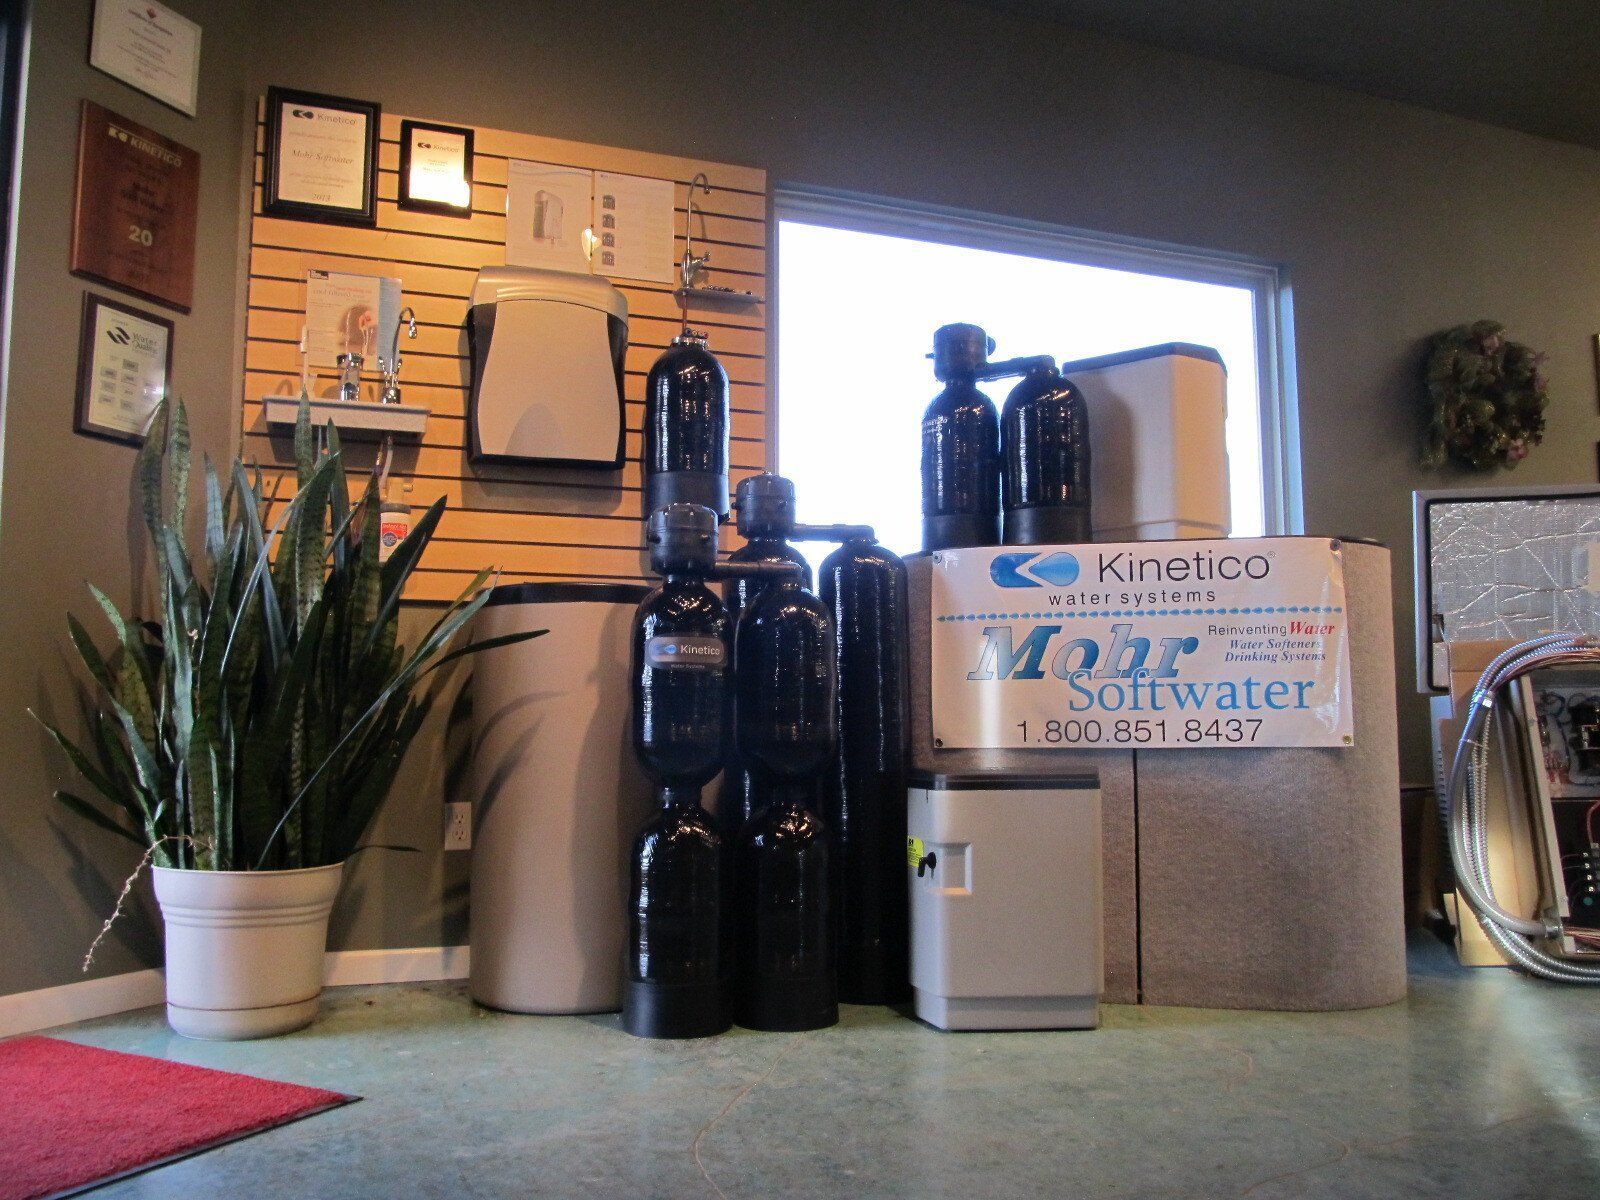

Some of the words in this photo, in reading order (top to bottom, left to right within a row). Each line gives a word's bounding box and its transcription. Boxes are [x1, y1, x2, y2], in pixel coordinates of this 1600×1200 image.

[317, 112, 356, 126] Kinetico
[130, 137, 183, 168] KINETICO
[129, 225, 153, 247] 20
[1098, 551, 1271, 584] Kinetico
[1048, 592, 1112, 606] water
[1120, 588, 1217, 607] systems
[1208, 624, 1287, 637] Reinventing
[1289, 620, 1335, 635] Water
[680, 644, 721, 655] Kinetico
[966, 623, 1199, 681] Mohr
[1229, 639, 1263, 650] Water
[1266, 638, 1321, 651] Softeners
[1224, 651, 1277, 663] Drinking
[1280, 650, 1326, 663] Systems
[1068, 667, 1316, 713] Softwater
[1016, 718, 1263, 743] 1.800.851.8437
